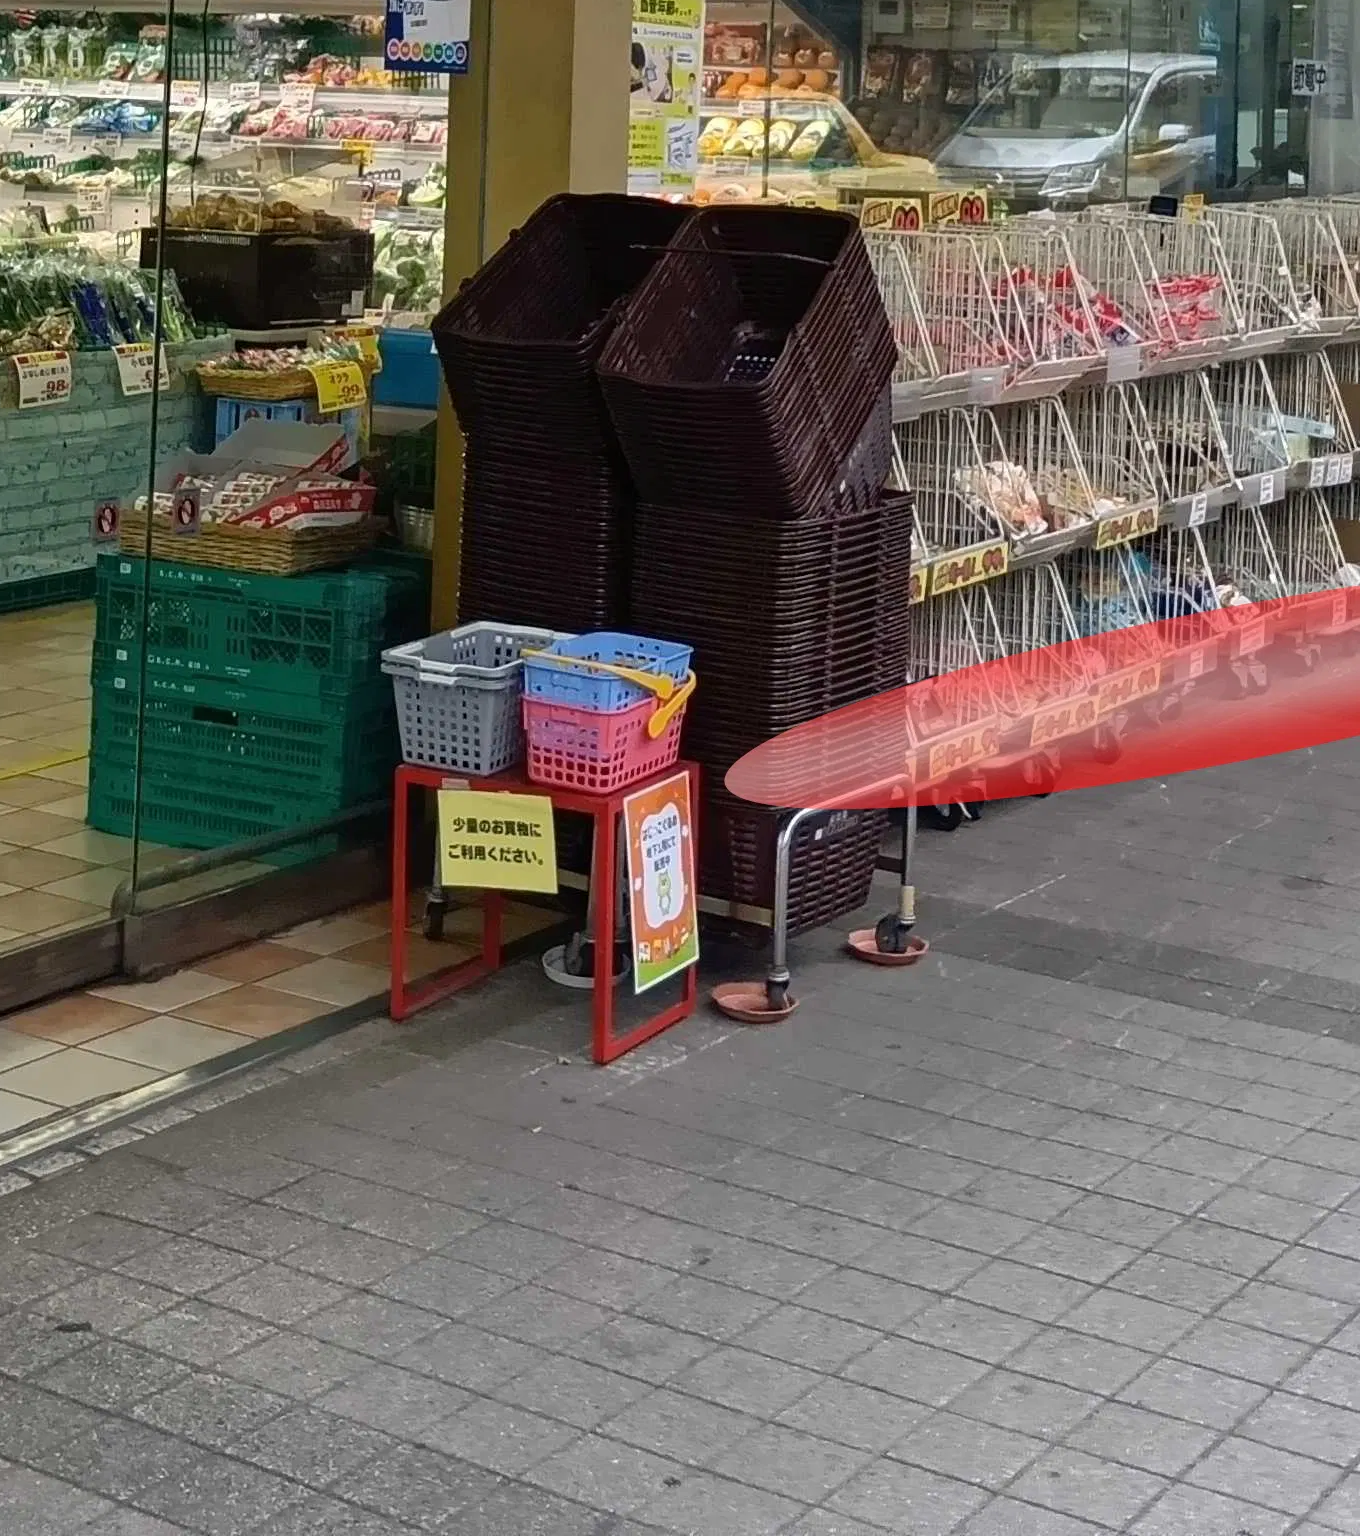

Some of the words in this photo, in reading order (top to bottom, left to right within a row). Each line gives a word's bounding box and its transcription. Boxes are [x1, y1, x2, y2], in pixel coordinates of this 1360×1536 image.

[453, 816, 542, 838] 少量のお買物に
[448, 844, 544, 866] ご利用ください。
